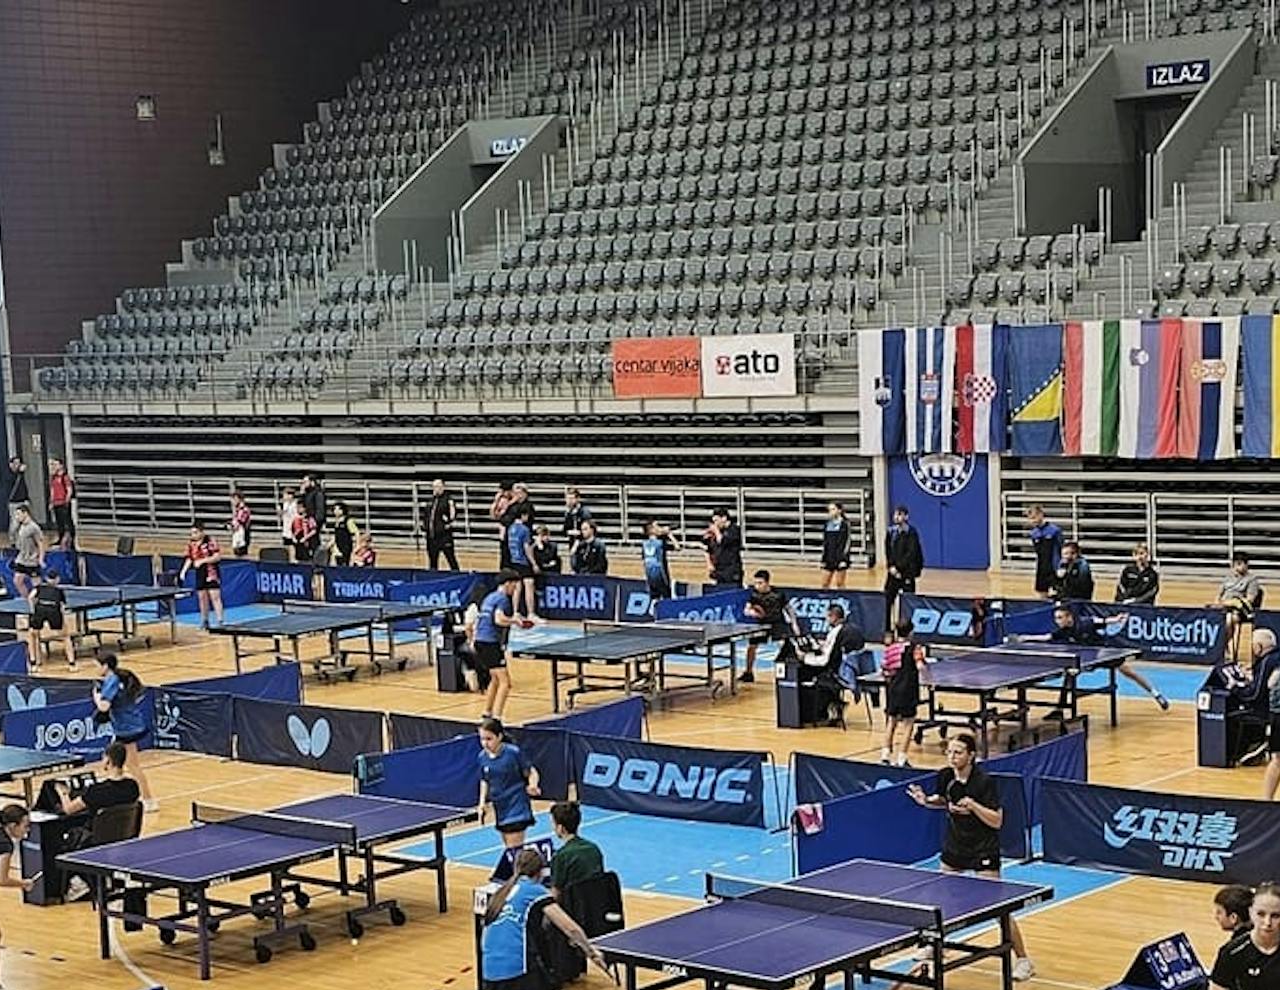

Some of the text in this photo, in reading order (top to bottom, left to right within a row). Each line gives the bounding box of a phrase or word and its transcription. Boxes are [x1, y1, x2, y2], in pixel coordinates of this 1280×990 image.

[1152, 63, 1204, 86] IZLAZ
[615, 358, 657, 374] centar
[734, 350, 780, 375] ato
[256, 572, 305, 596] IBHAR
[333, 581, 385, 598] TIBHAR
[540, 585, 605, 611] BHAR
[1128, 616, 1220, 647] Butterfly
[583, 752, 752, 804] DONIC
[1159, 844, 1233, 872] DHS
